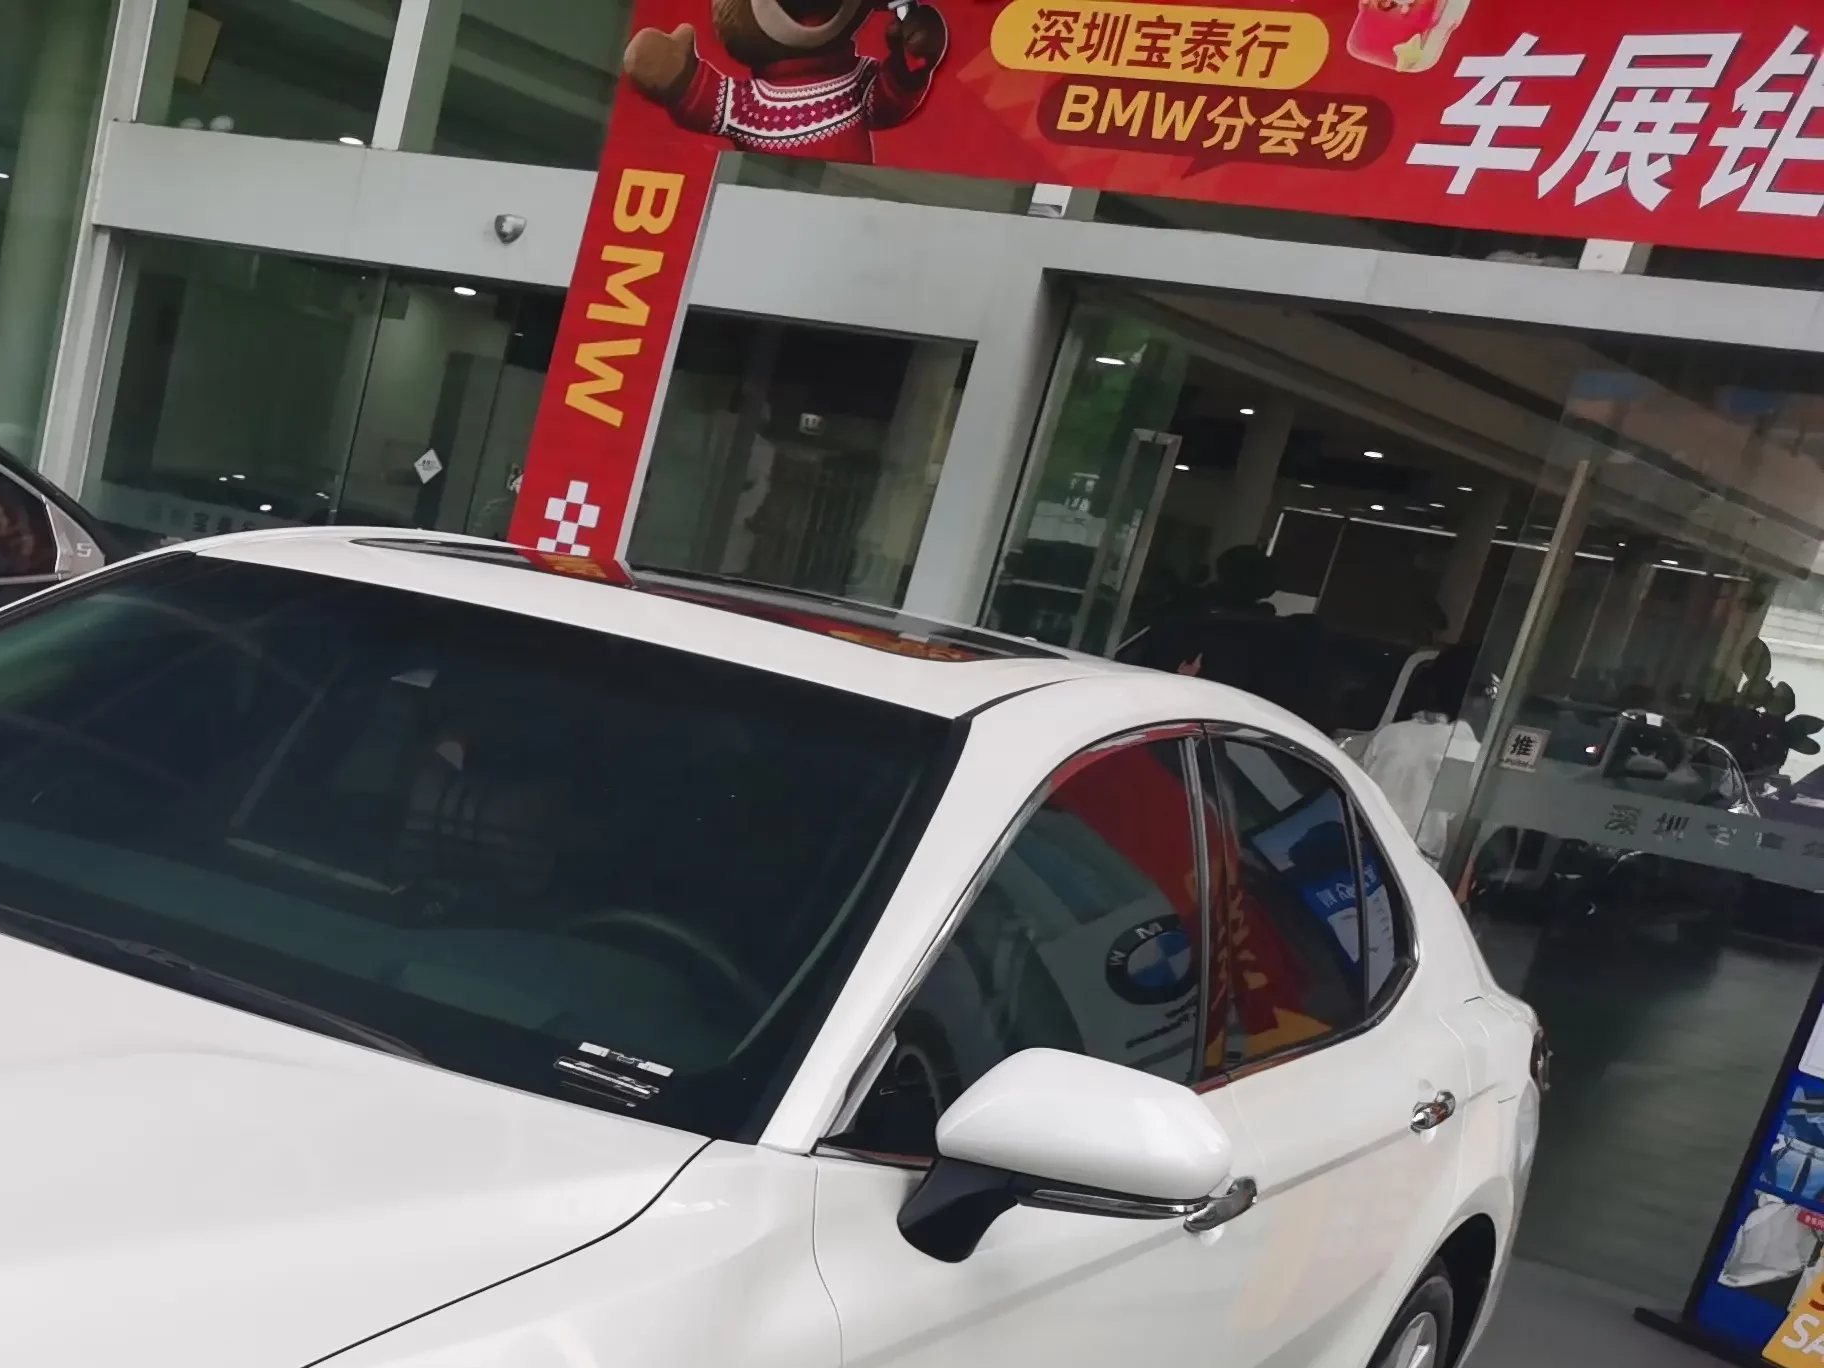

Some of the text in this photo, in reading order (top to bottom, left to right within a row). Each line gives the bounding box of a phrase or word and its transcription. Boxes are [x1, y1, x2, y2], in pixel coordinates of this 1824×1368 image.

[1024, 8, 1289, 79] 深圳宝泰行
[1057, 84, 1369, 162] BMW分会场
[564, 168, 685, 428] BMW
